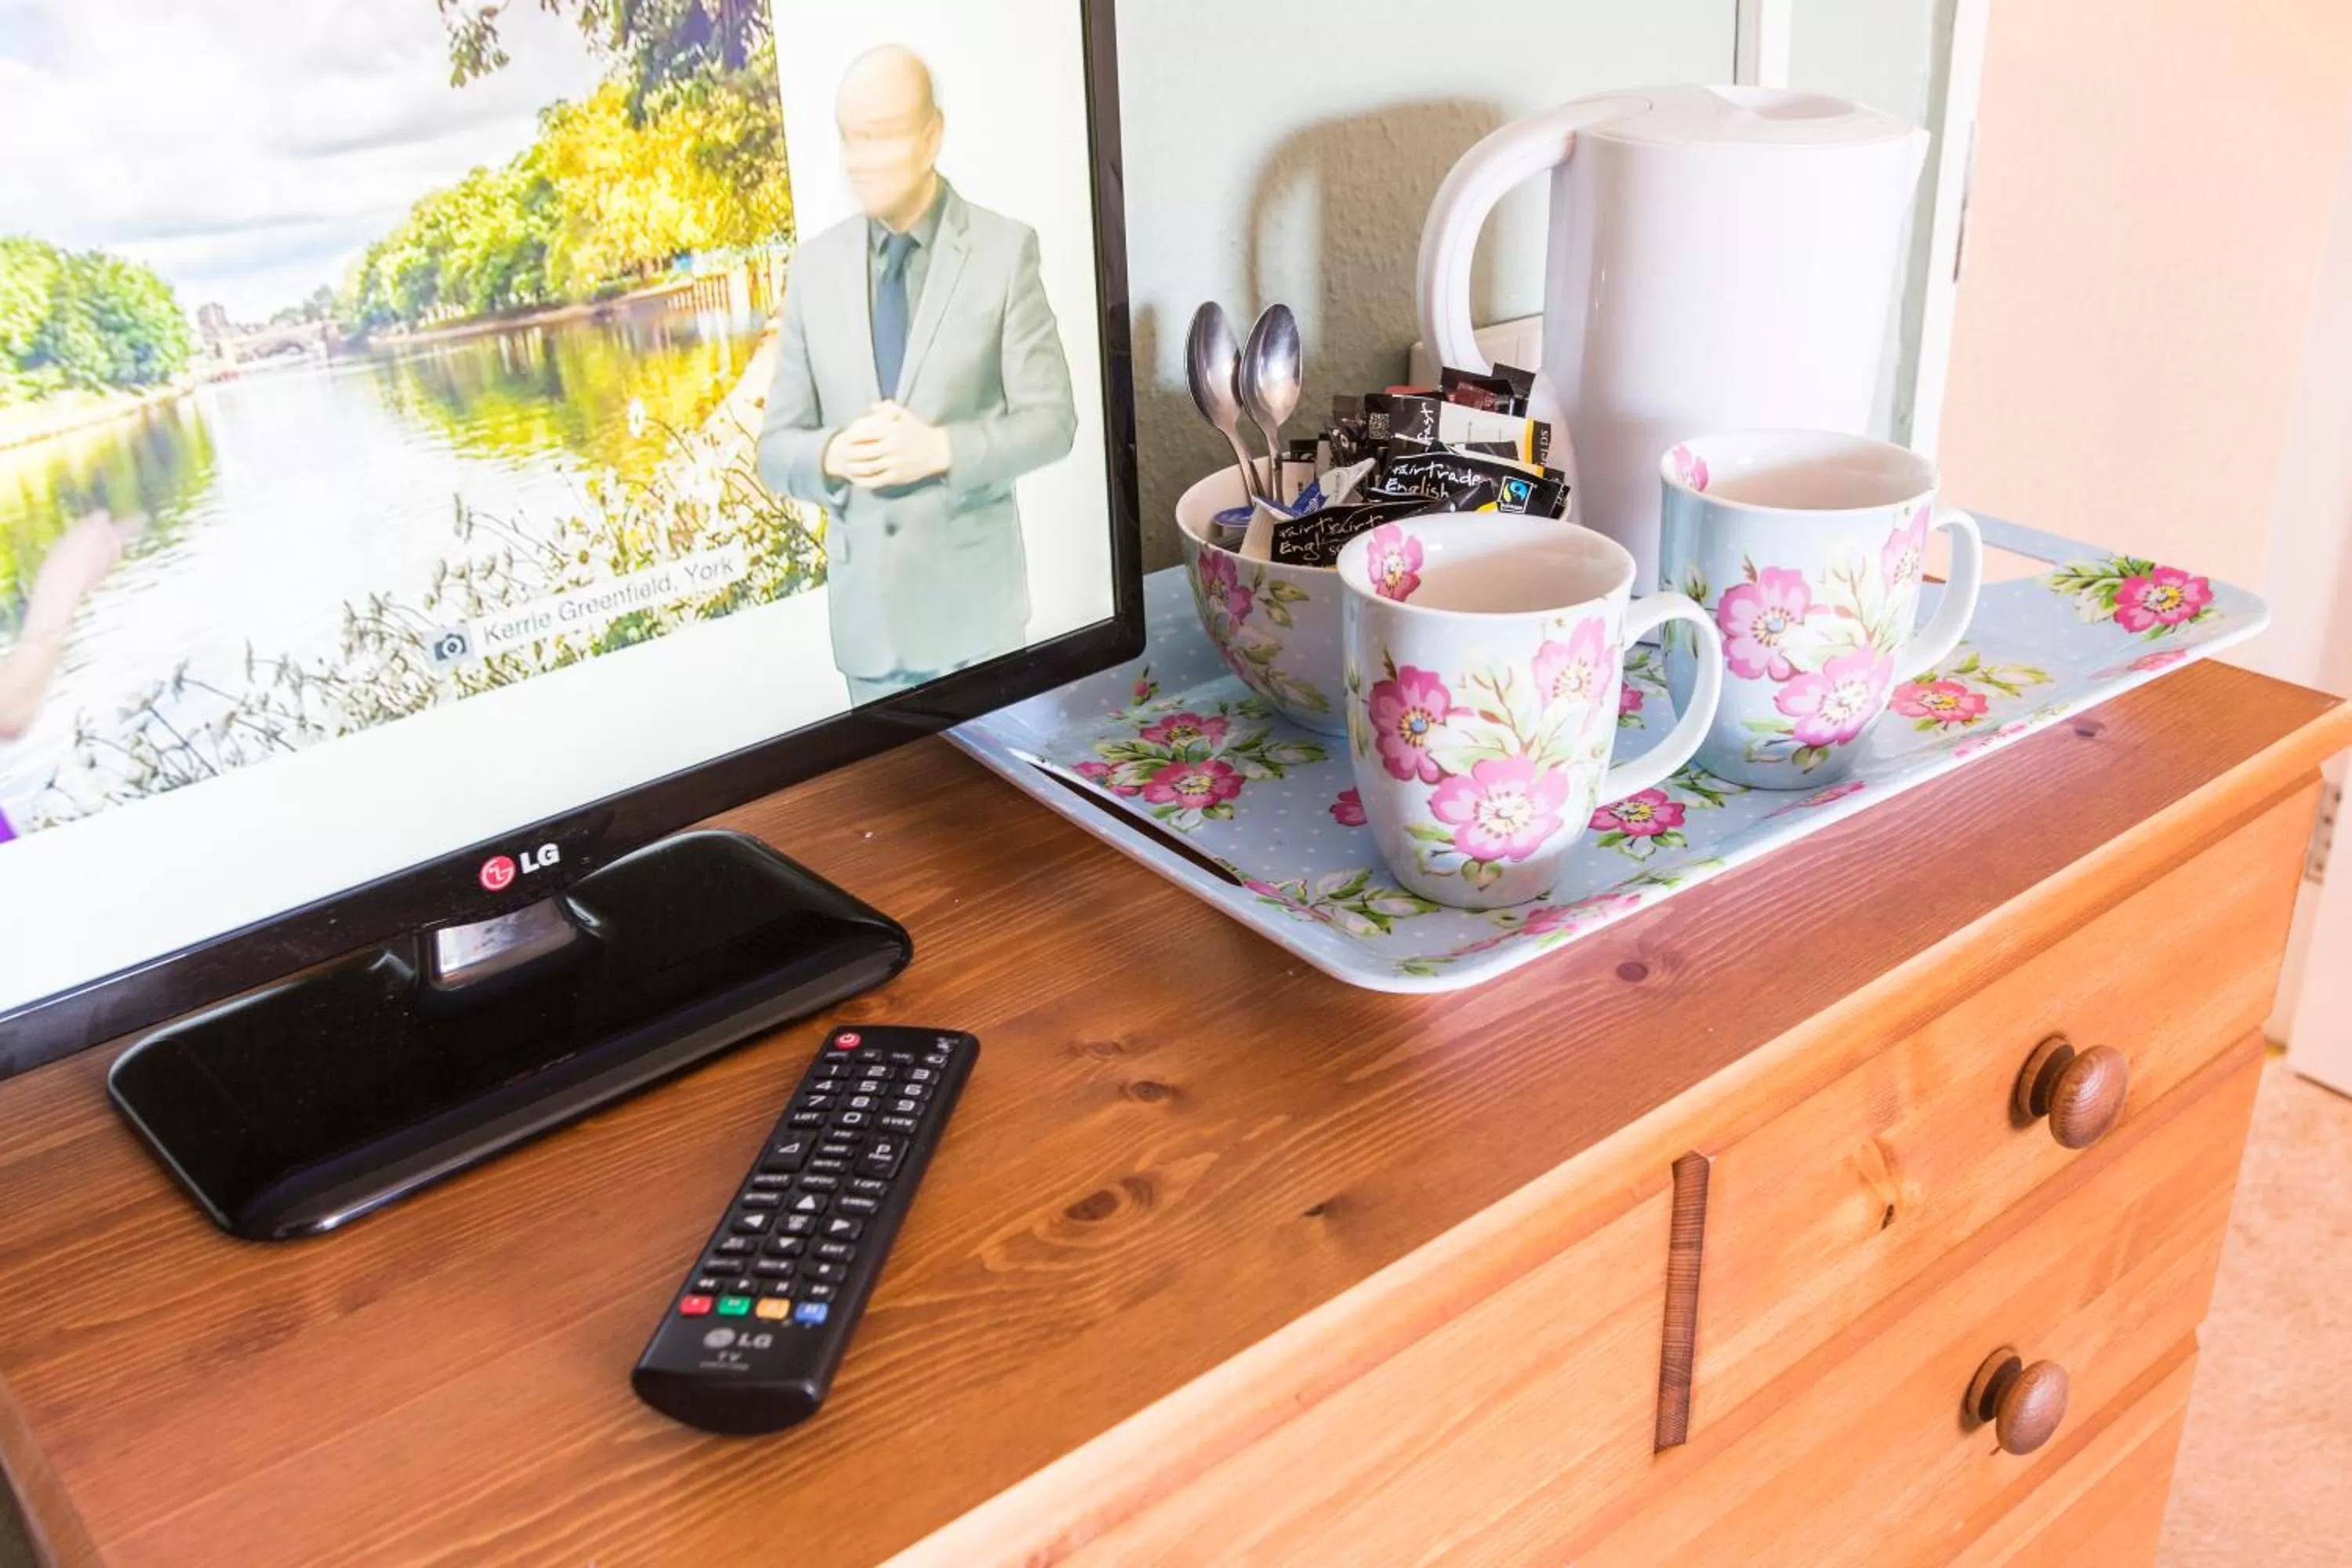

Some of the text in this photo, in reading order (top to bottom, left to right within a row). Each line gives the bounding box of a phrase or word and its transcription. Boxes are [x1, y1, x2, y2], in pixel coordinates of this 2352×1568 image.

[484, 556, 735, 645] Kerrie Greenfield, York
[519, 843, 561, 874] LG
[830, 1065, 931, 1080] 1 2 3
[815, 1080, 923, 1095] 4 5 6
[808, 1095, 916, 1111] 7 8 9
[842, 1112, 862, 1123] 0
[738, 1333, 773, 1349] LG
